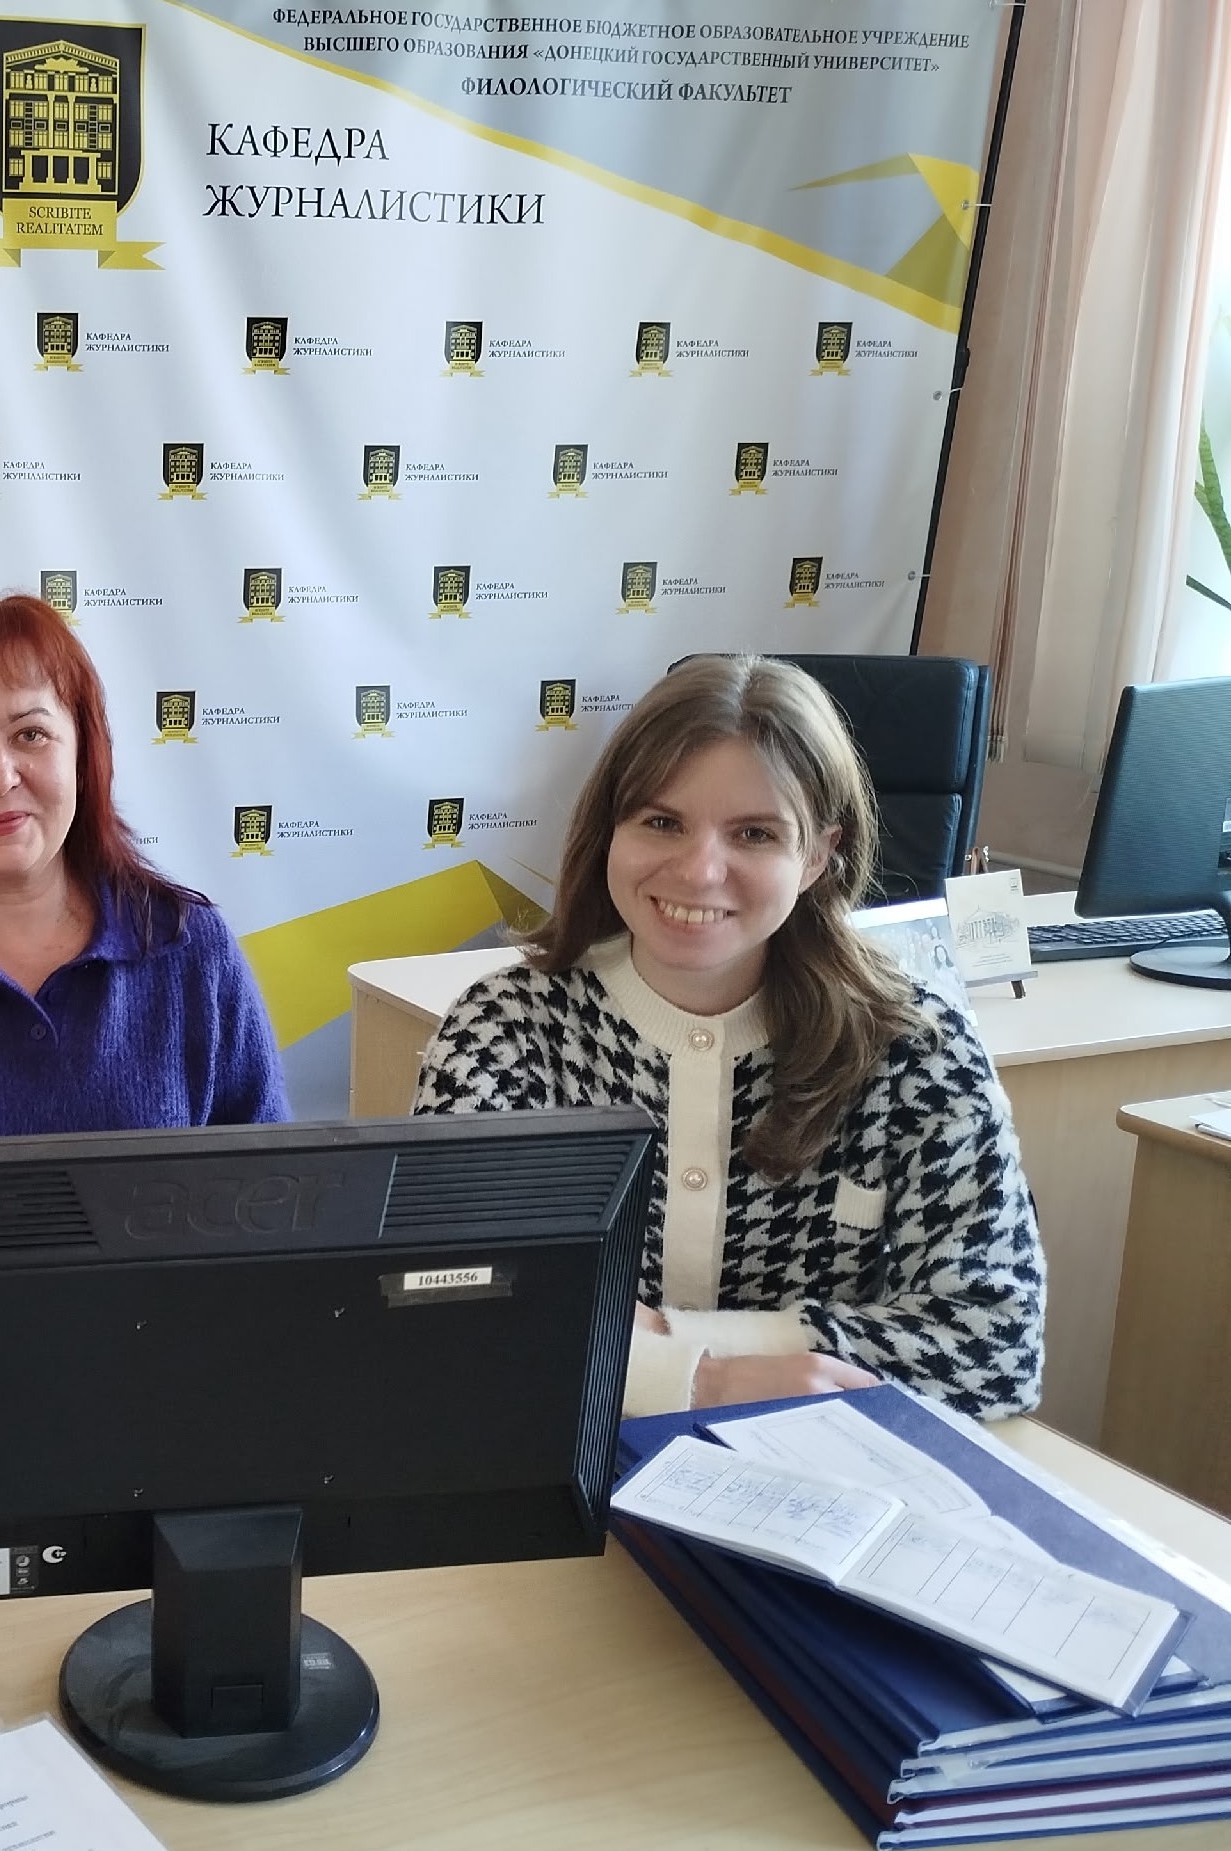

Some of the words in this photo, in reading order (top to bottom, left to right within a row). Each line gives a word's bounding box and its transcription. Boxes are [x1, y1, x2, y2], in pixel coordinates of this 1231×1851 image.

[272, 6, 408, 27] ФЕДЕРАЛЬНОЕ
[411, 11, 582, 34] ГОСУДАРСТВЕННОЕ
[585, 18, 696, 38] БЮДЖЕТНОЕ
[699, 23, 859, 45] ОБРАЗОВАТЕЛЬНОЕ
[861, 29, 971, 49] УЧРЕЖДЕНИЕ
[303, 36, 399, 53] ВЫСШЕГО
[403, 38, 529, 59] ОБРАЗОВАНИЯ
[532, 43, 639, 65] «ДОНЕЦКИЙ
[642, 49, 810, 70] ГОСУДАРСТВЕННЫЙ
[813, 56, 941, 73] УНИВЕРСИТЕТ»
[460, 76, 673, 101] ФИЛОЛОГИЧЕСКИЙ
[677, 81, 793, 105] ФАКУЛЬТЕТ
[206, 122, 391, 167] КАФЕДРА
[202, 184, 547, 226] ЖУРНАЛИСТИКИ
[27, 205, 93, 221] SCRIBITE
[15, 221, 105, 237] REALITATEM
[86, 332, 132, 342] КАФЕДРА
[294, 336, 338, 346] КАФЕДРА
[85, 343, 170, 353] ЖУРНАЛИСТИКИ
[489, 338, 533, 348] КАФЕДРА
[677, 339, 720, 349] КАФЕДРА
[856, 340, 893, 349] КАФЕДРА
[293, 347, 373, 357] ЖУРНАЛИСТИКИ
[488, 349, 566, 359] ЖУРНАЛИСТИКИ
[676, 350, 750, 358] ЖУРНАЛИСТИКИ
[854, 350, 919, 359] ЖУРНАЛИСТИКИ
[2, 460, 46, 471] КАФЕДРА
[210, 461, 253, 472] КАФЕДРА
[405, 462, 446, 473] КАФЕДРА
[592, 461, 635, 470] КАФЕДРА
[772, 458, 811, 468] КАФЕДРА
[2, 472, 82, 482] ЖУРНАЛИСТИКИ
[209, 472, 285, 483] ЖУРНАЛИСТИКИ
[404, 473, 480, 483] ЖУРНАЛИСТИКИ
[591, 471, 669, 481] ЖУРНАЛИСТИКИ
[771, 468, 839, 478] ЖУРНАЛИСТИКИ
[825, 571, 860, 581] КАФЕДРА
[475, 581, 516, 592] КАФЕДРА
[662, 577, 700, 587] КАФЕДРА
[823, 580, 886, 590] ЖУРНАЛИСТИКИ
[83, 587, 127, 598] КАФЕДРА
[288, 585, 328, 595] КАФЕДРА
[660, 586, 727, 597] ЖУРНАЛИСТИКИ
[288, 595, 360, 604] ЖУРНАЛИСТИКИ
[475, 591, 549, 601] ЖУРНАЛИСТИКИ
[83, 598, 164, 608] ЖУРНАЛИСТИКИ
[581, 694, 621, 703] КАФЕДРА
[201, 706, 246, 717] КАФЕДРА
[396, 702, 436, 712] КАФЕДРА
[580, 703, 636, 712] ЖУРНАЛИСТ
[396, 711, 469, 720] ЖУРНАЛИСТИКИ
[201, 716, 281, 726] ЖУРНАЛИСТИКИ
[468, 812, 509, 822] КАФЕДРА
[277, 820, 321, 832] КАФЕДРА
[467, 820, 538, 831] ЖУРНАЛИСТИКИ
[276, 829, 354, 840] ЖУРНАЛИСТИКИ
[125, 1171, 346, 1240] acer
[417, 1272, 479, 1287] 10443556
